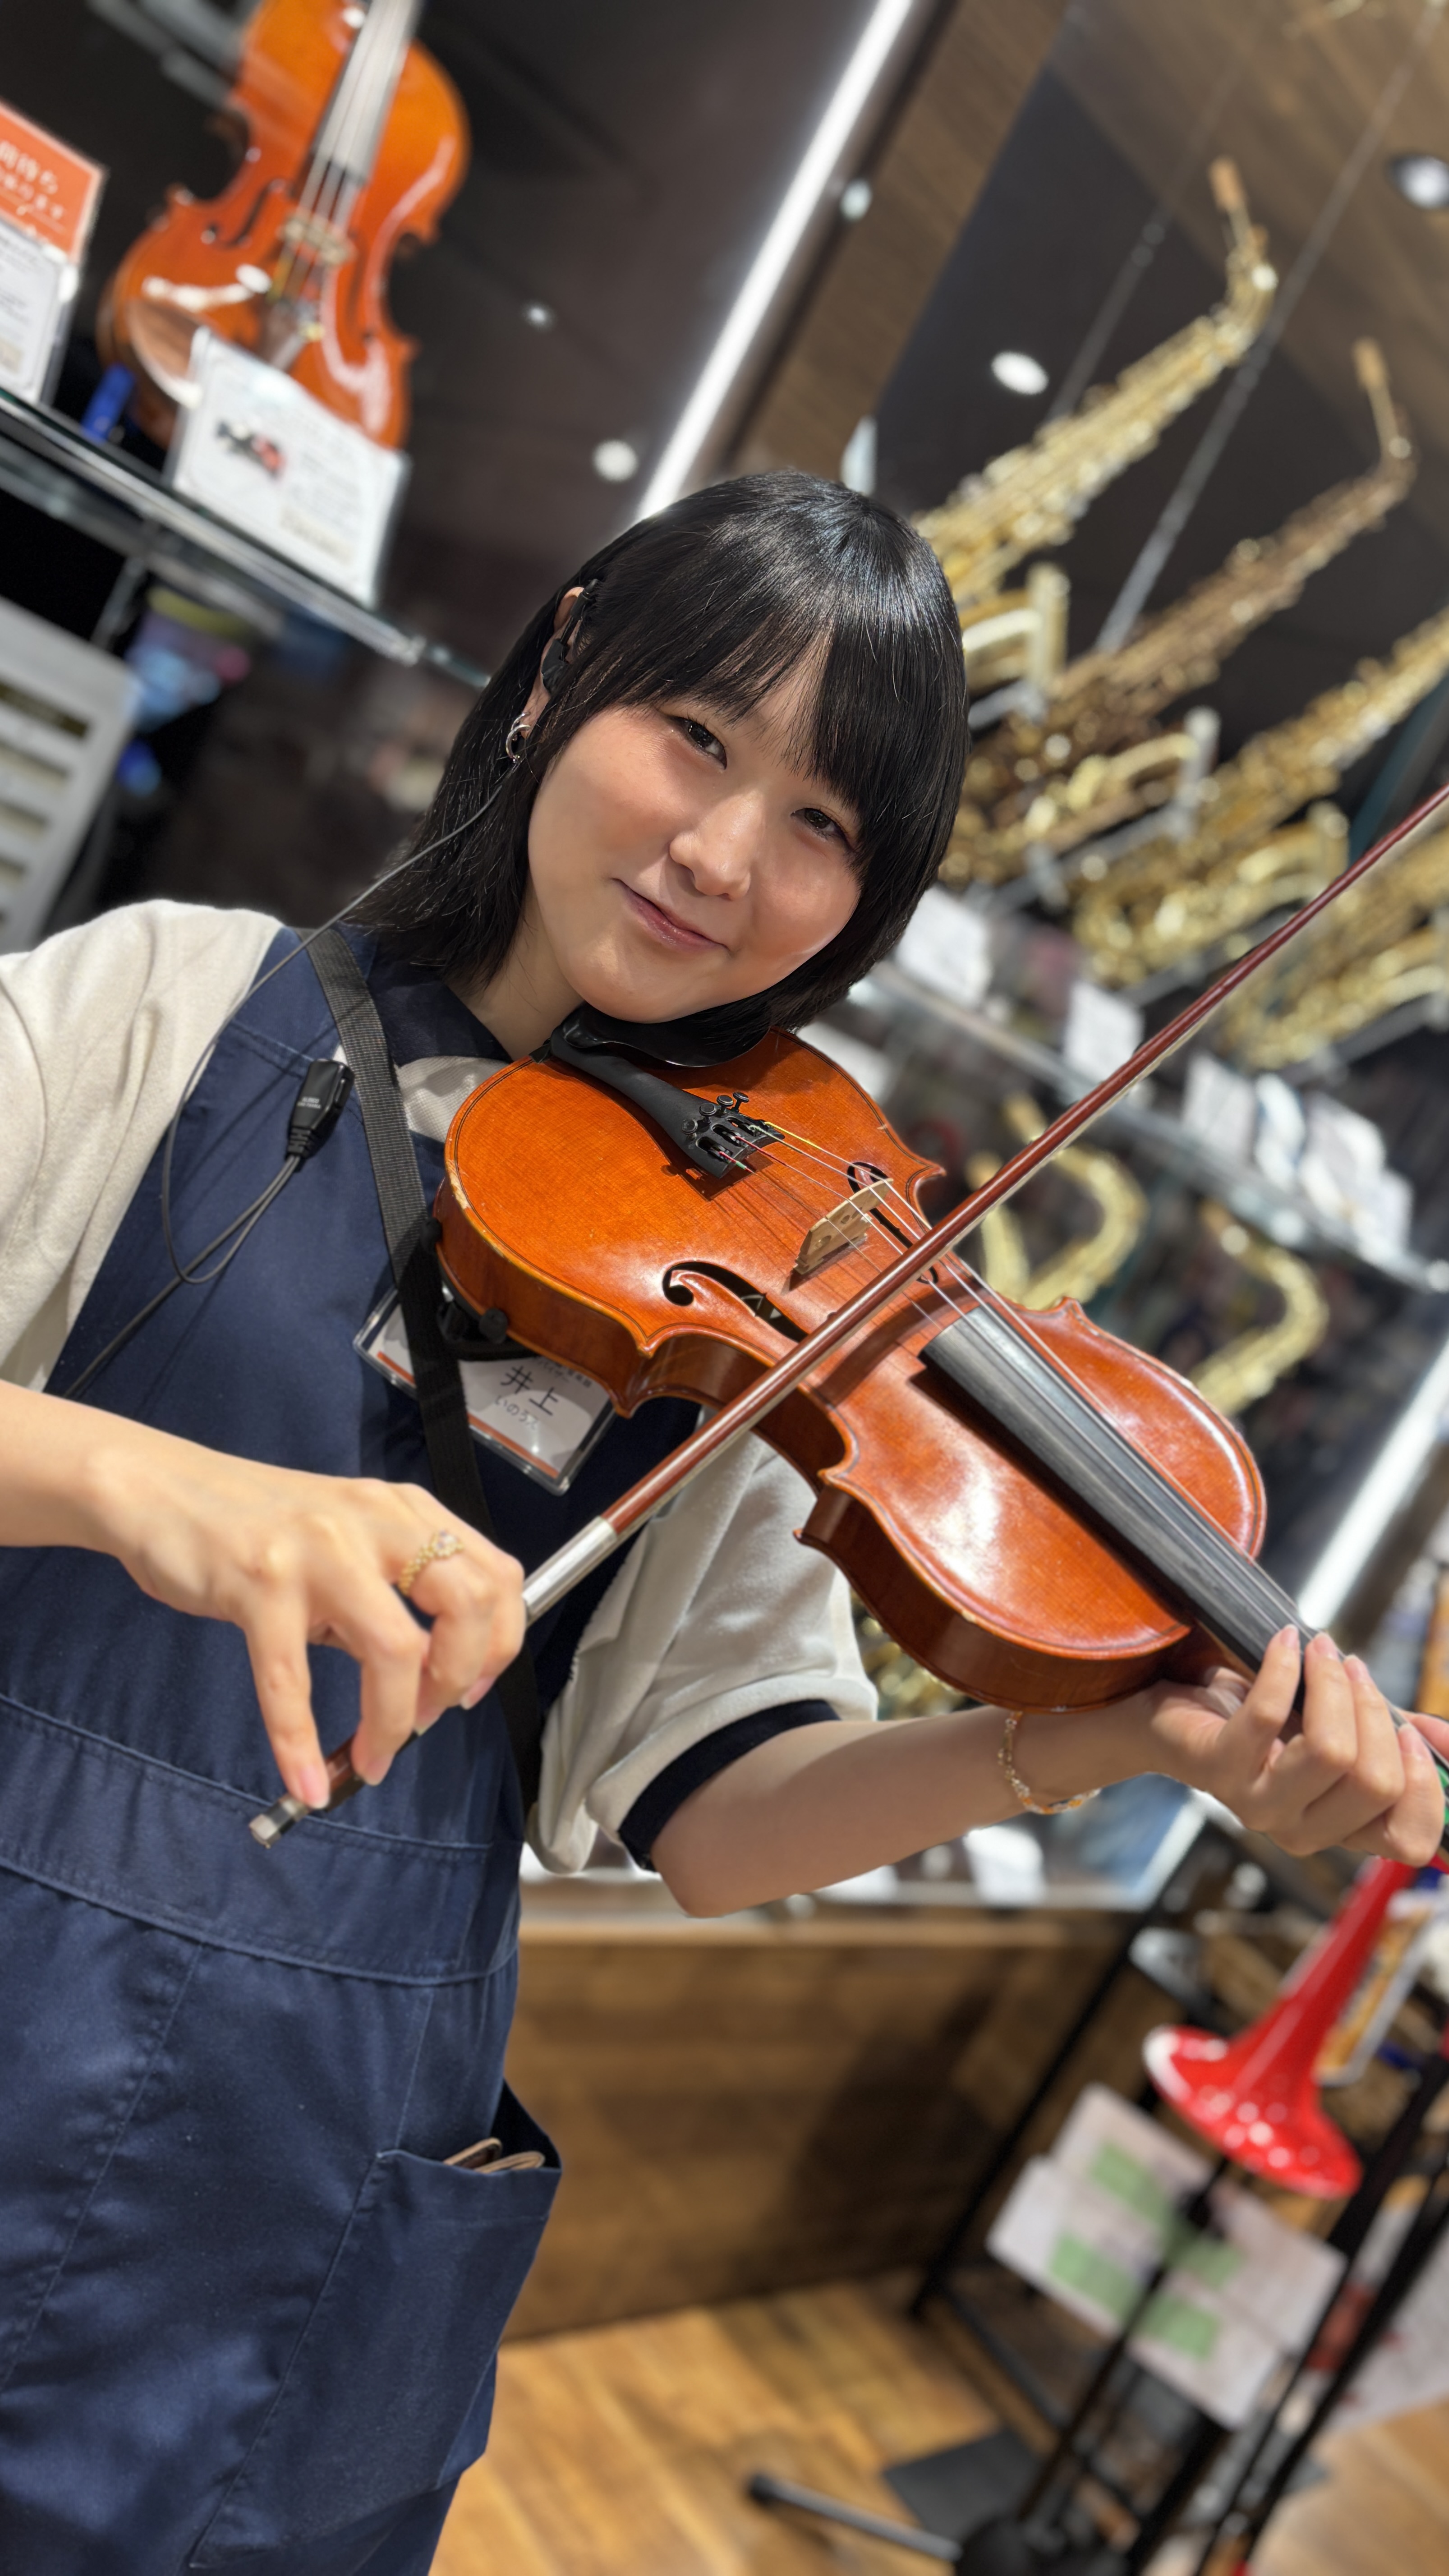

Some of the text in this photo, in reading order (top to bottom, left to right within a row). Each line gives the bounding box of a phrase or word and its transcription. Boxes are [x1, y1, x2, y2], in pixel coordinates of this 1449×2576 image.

[500, 1366, 559, 1416] 井上
[494, 1396, 539, 1430] いのうえ
